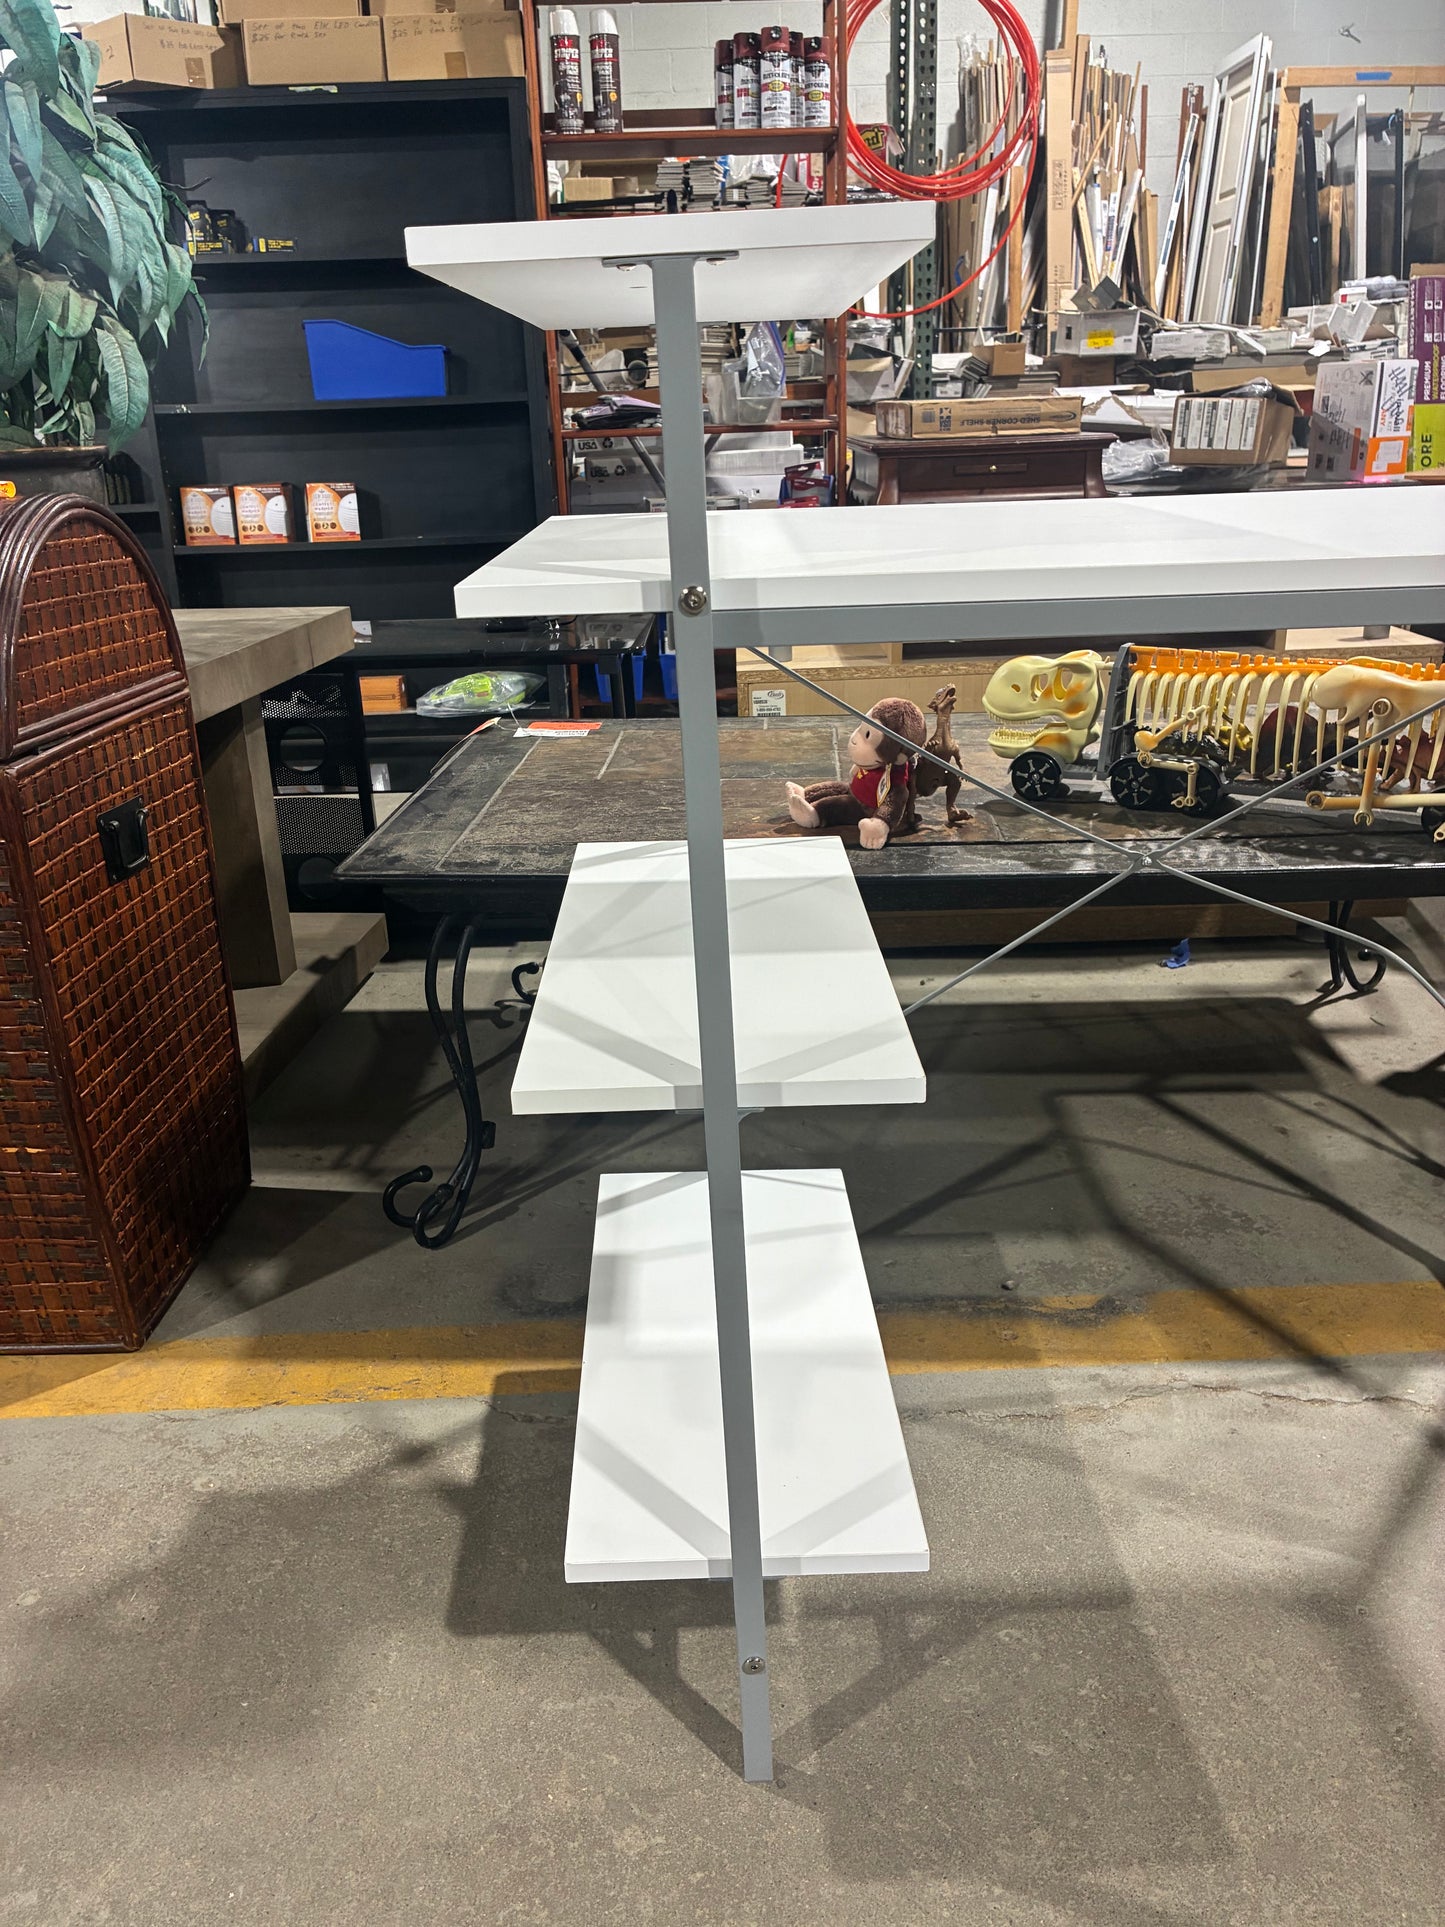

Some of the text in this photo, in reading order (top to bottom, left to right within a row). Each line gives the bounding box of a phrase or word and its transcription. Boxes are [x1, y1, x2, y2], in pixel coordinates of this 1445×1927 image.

[1423, 360, 1432, 401] PREMIUM
[1432, 343, 1441, 401] WATERPROOF
[959, 418, 985, 427] SHELF
[985, 416, 1018, 425] CORNER
[577, 441, 598, 451] USA
[1420, 433, 1432, 470] ORE
